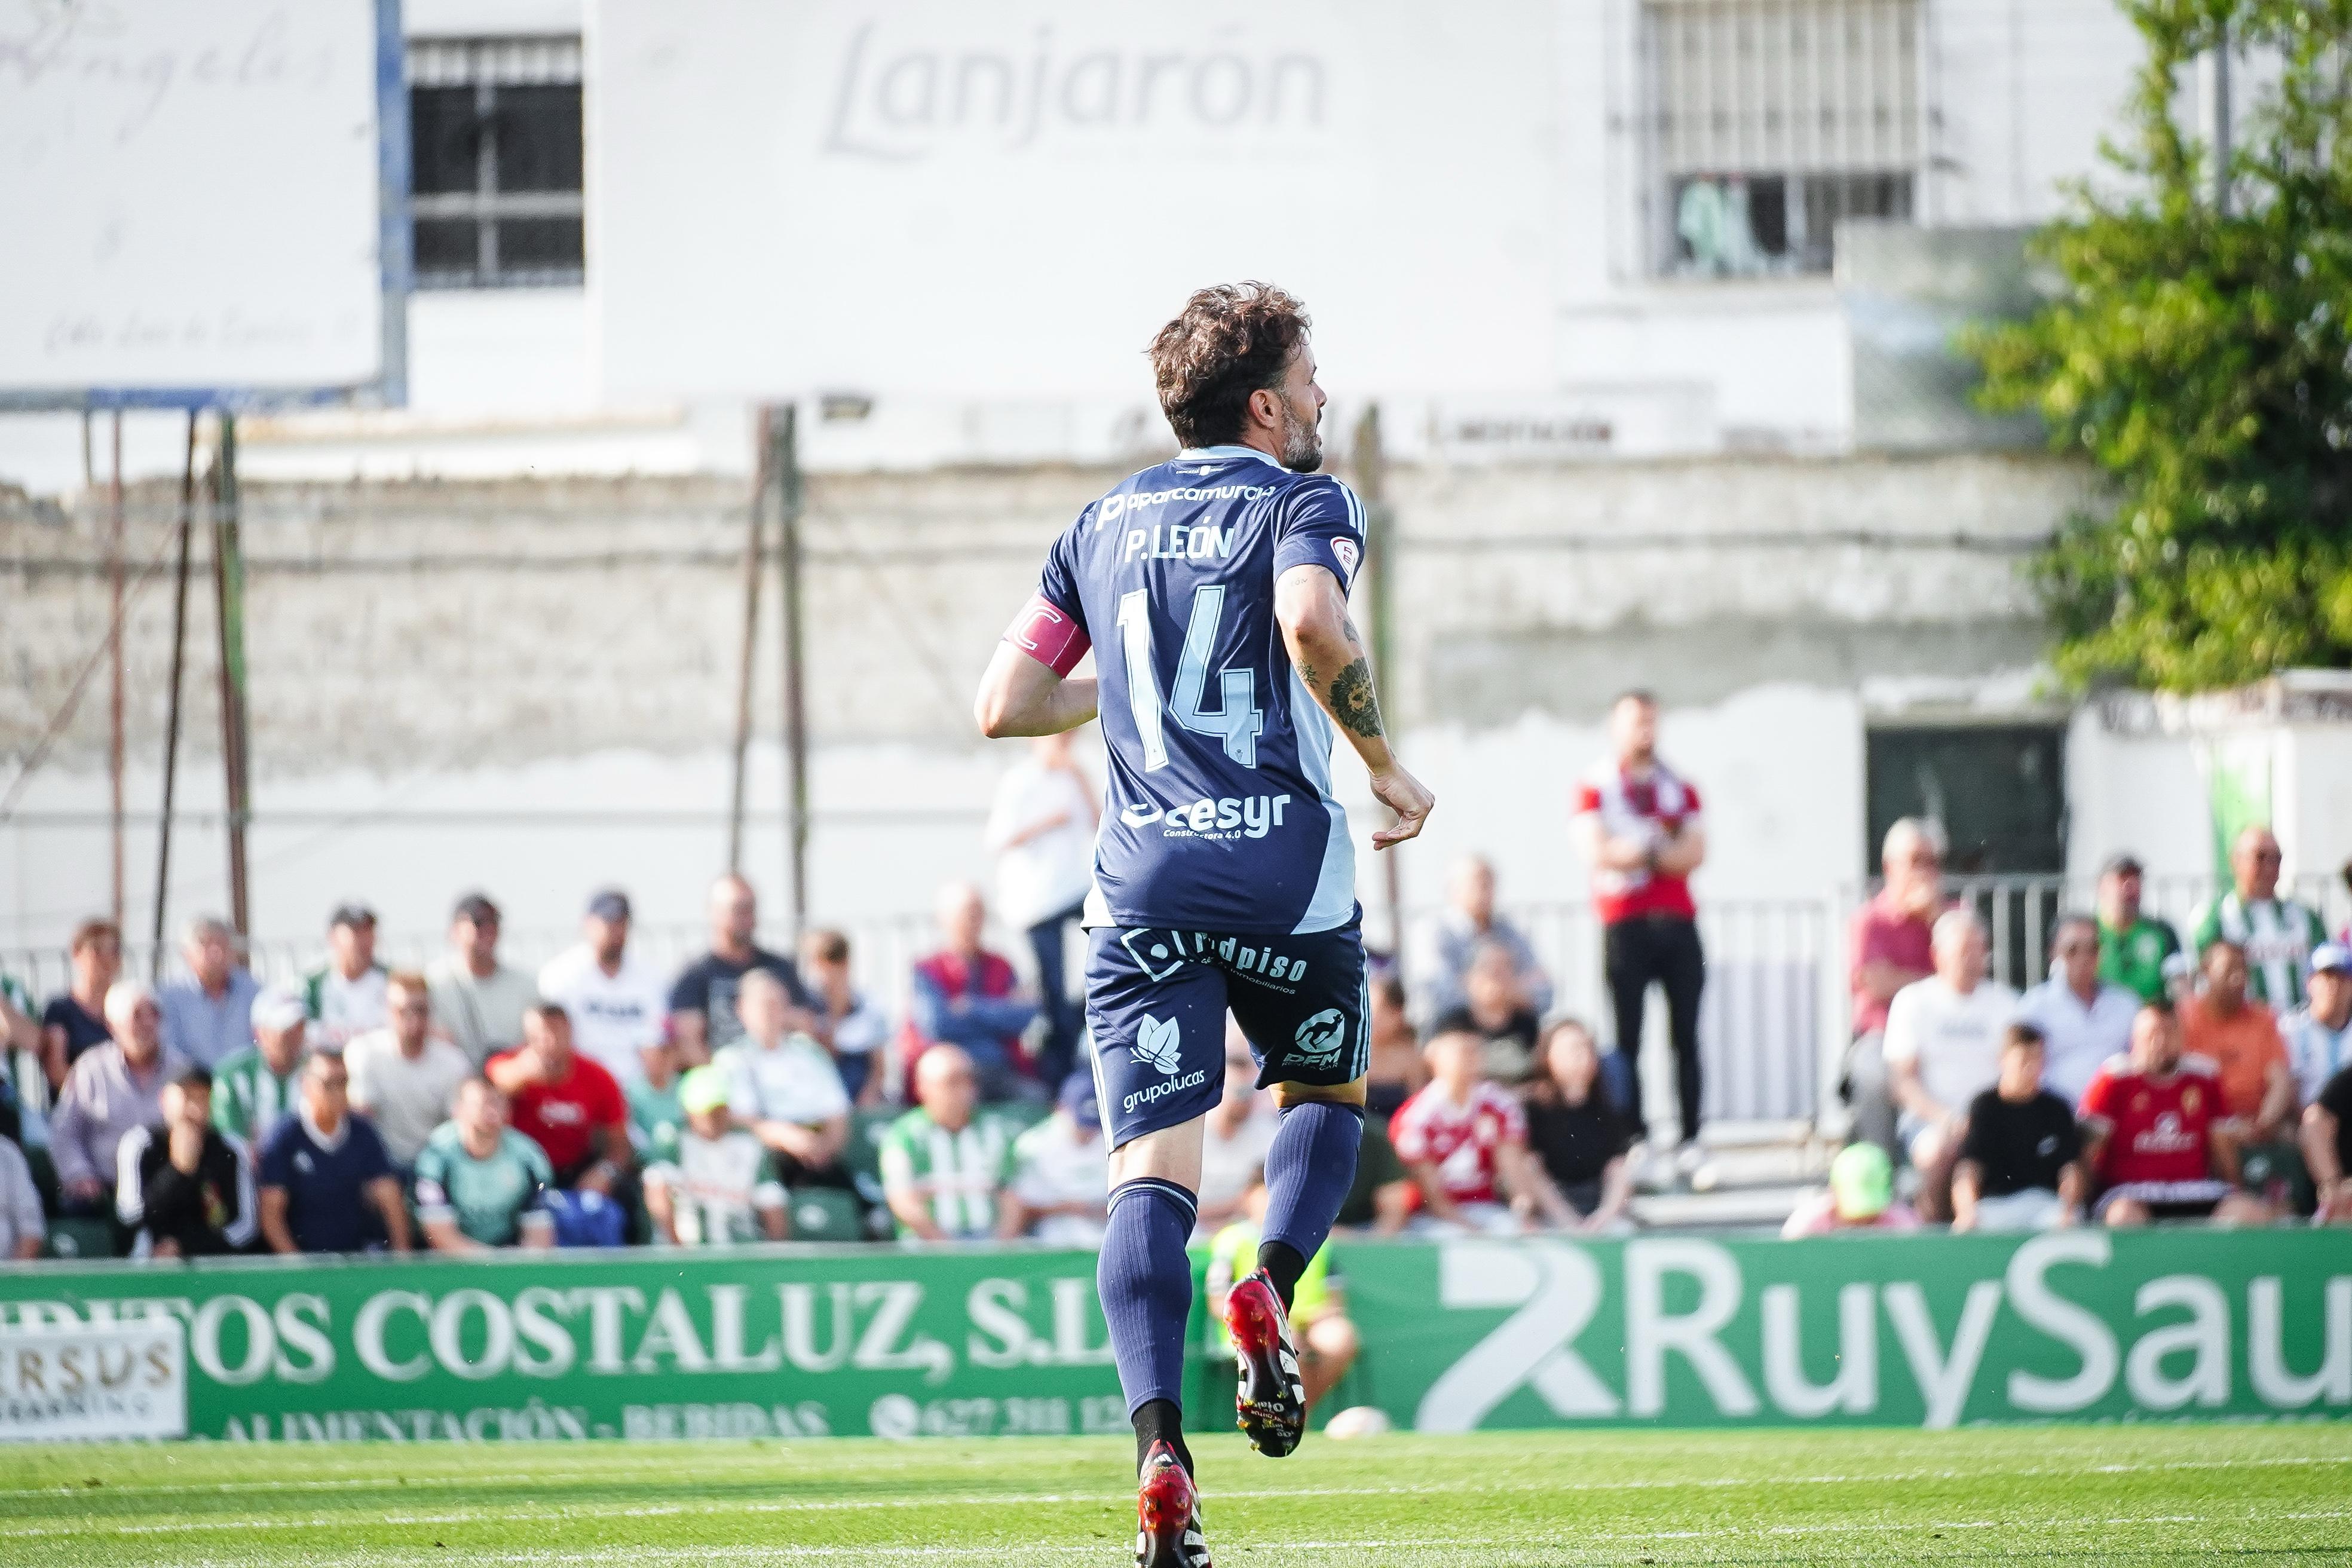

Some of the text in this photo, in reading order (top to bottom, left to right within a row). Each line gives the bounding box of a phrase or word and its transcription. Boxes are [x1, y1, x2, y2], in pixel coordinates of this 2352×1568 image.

[819, 17, 1328, 164] Lanjarón
[1123, 515, 1235, 564] P.LEÓN
[1013, 605, 1062, 651] C
[1116, 584, 1263, 773] 14
[1165, 794, 1291, 838] cesyr
[1224, 829, 1241, 839] 4.0
[1195, 931, 1307, 982] rdpiso
[1123, 1068, 1205, 1114] grupolucas
[353, 1280, 953, 1385] COSTALUZ,
[0, 1342, 172, 1392] RSUS
